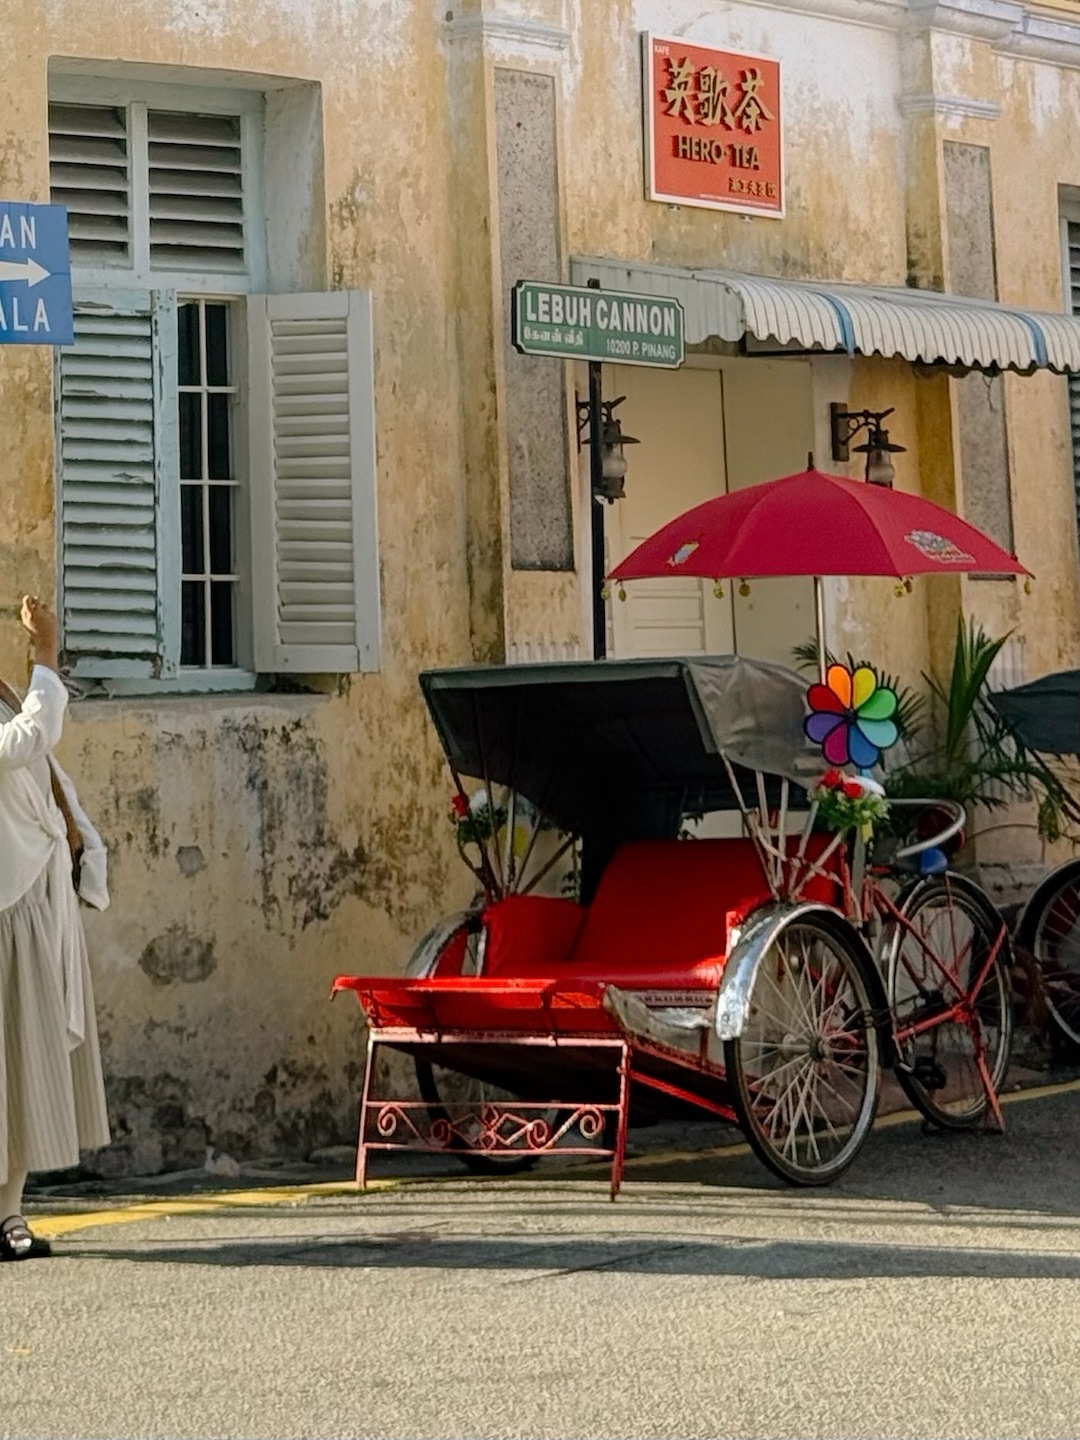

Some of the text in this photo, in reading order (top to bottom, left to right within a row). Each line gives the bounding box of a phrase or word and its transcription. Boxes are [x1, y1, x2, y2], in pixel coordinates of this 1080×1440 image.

[733, 144, 760, 171] TEA
[526, 291, 675, 337] LEBUH CANNON
[606, 338, 677, 361] 10200 P. PINANG
